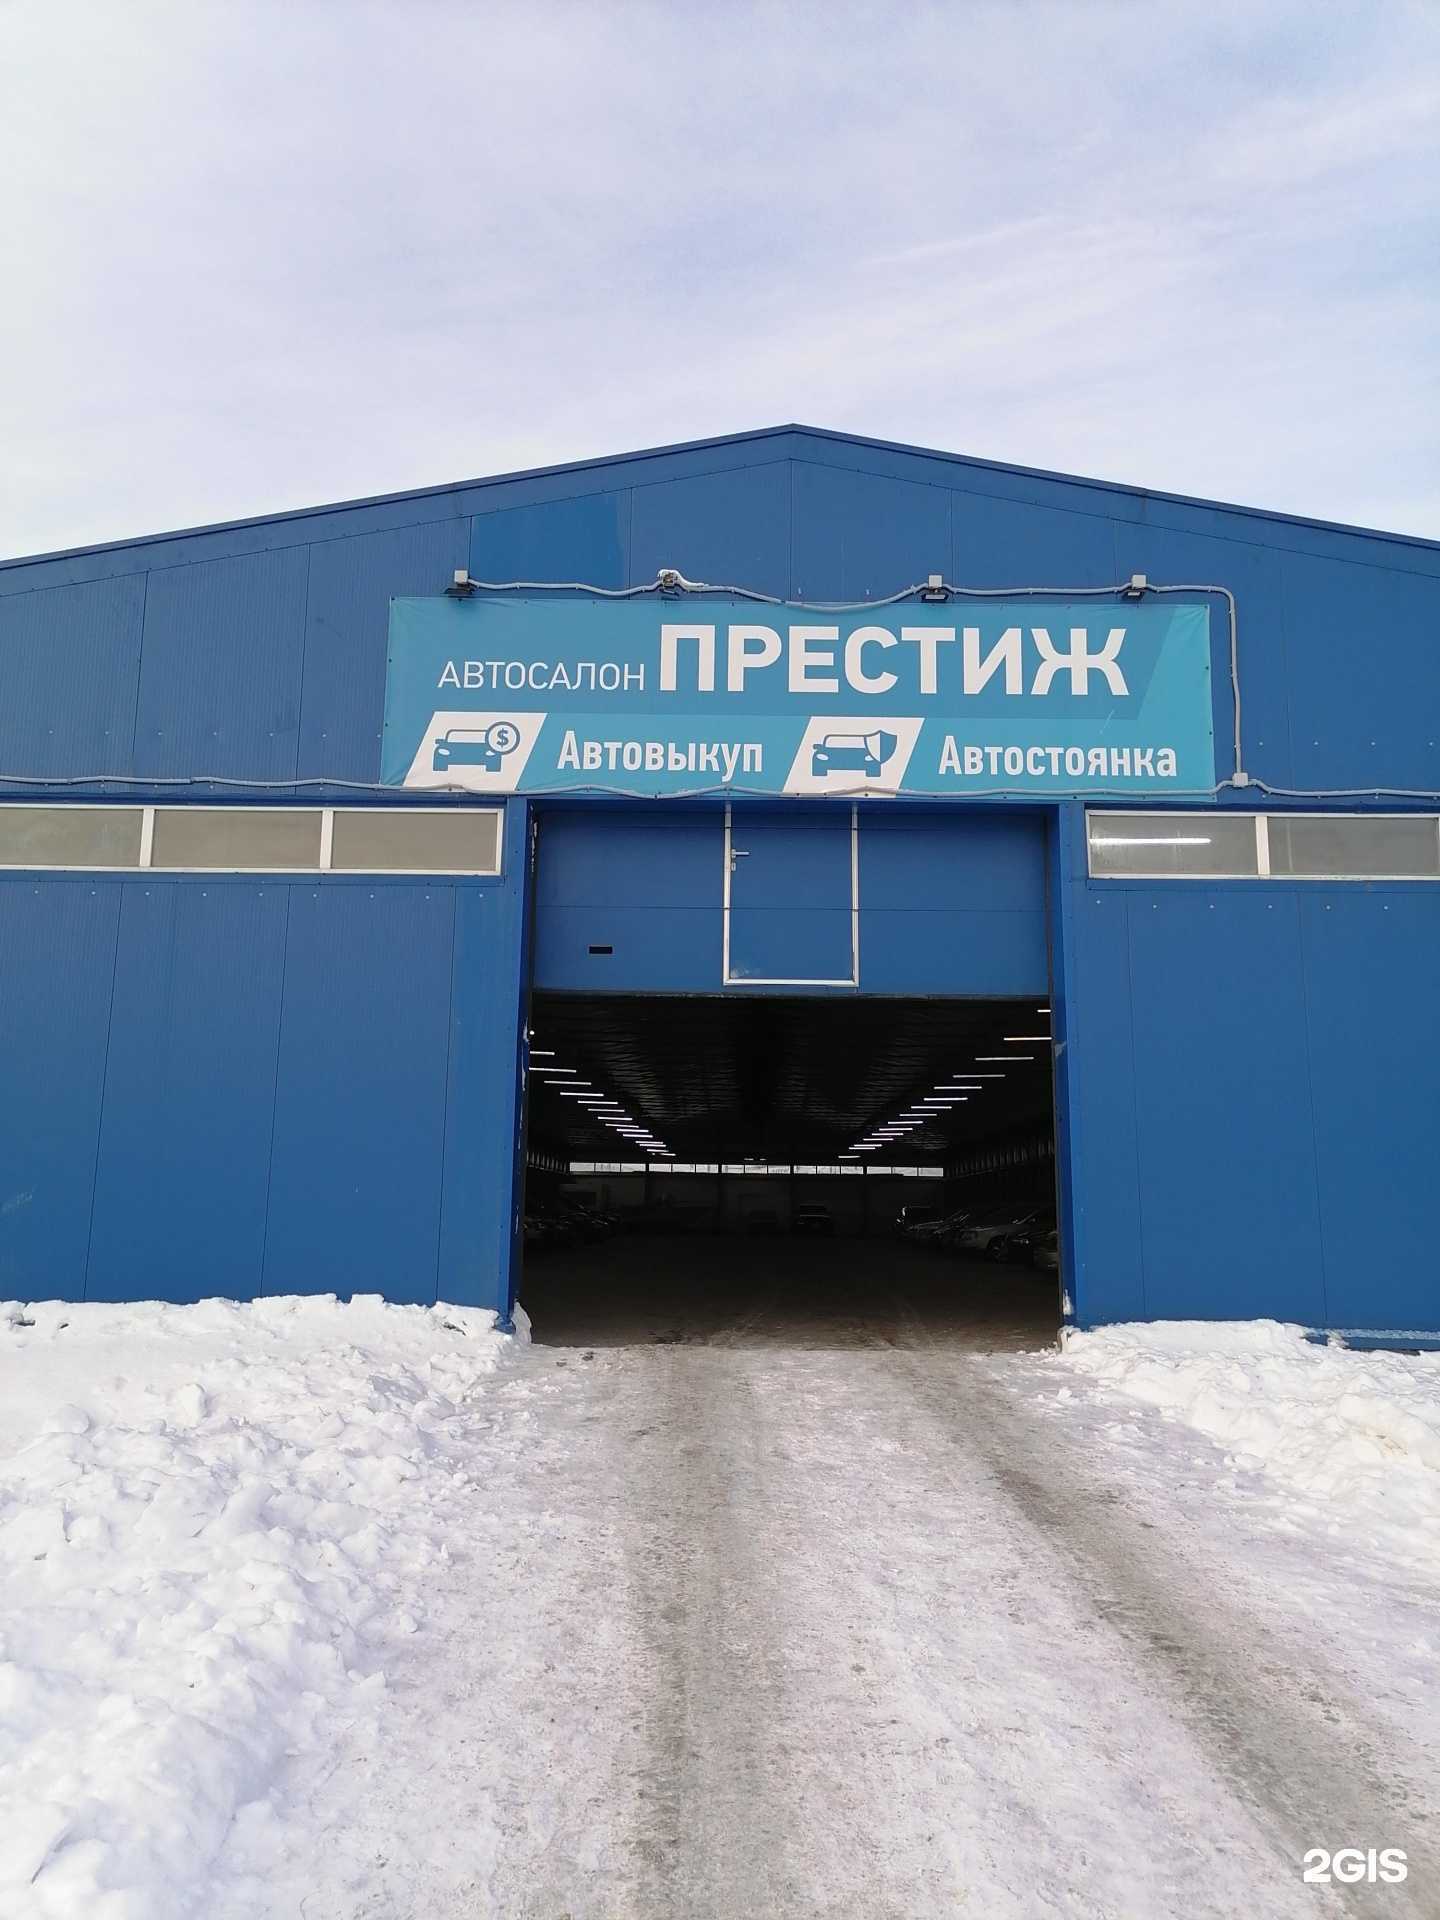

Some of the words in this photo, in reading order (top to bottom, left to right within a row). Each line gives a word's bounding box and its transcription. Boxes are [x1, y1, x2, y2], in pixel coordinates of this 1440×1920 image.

[437, 660, 645, 691] АВТОСАЛОН
[659, 623, 1130, 696] ПРЕСТИЖ
[556, 730, 763, 783] Автовыкуп
[938, 735, 1178, 777] Автостоянка
